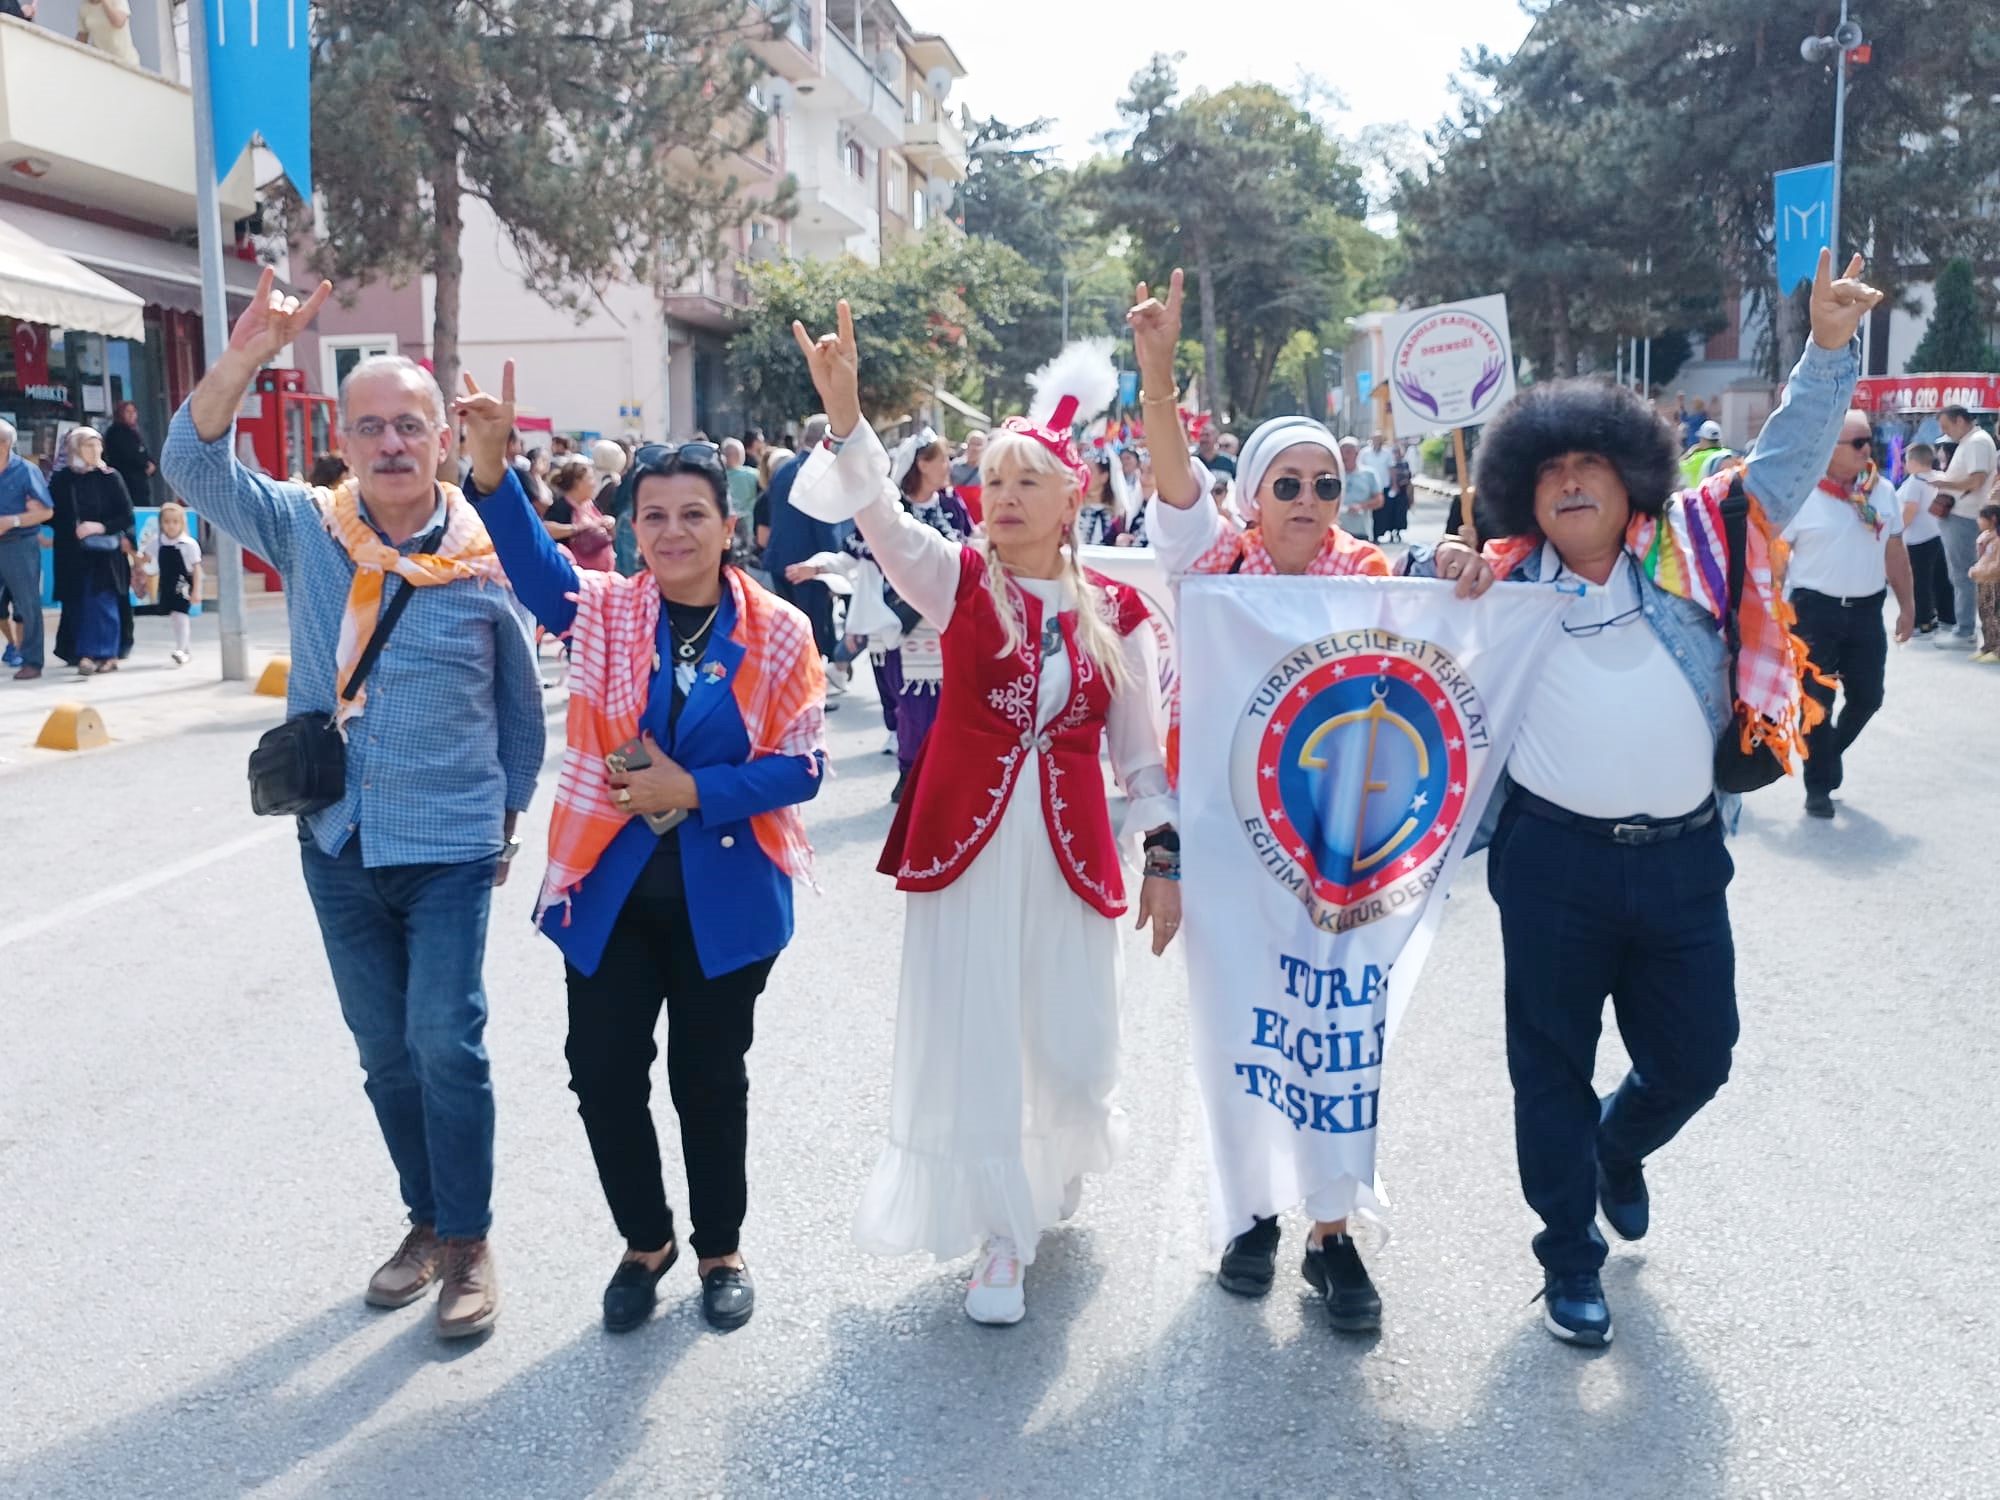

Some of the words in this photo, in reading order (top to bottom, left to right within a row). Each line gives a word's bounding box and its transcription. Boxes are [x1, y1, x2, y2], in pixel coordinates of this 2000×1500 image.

[1249, 651, 1314, 719] TURAN
[1316, 629, 1427, 660] ELÇİLERİ
[1432, 650, 1491, 750] TEŞKİLATI
[1245, 817, 1304, 891] EĞİTİM
[1280, 953, 1393, 1009] TURA
